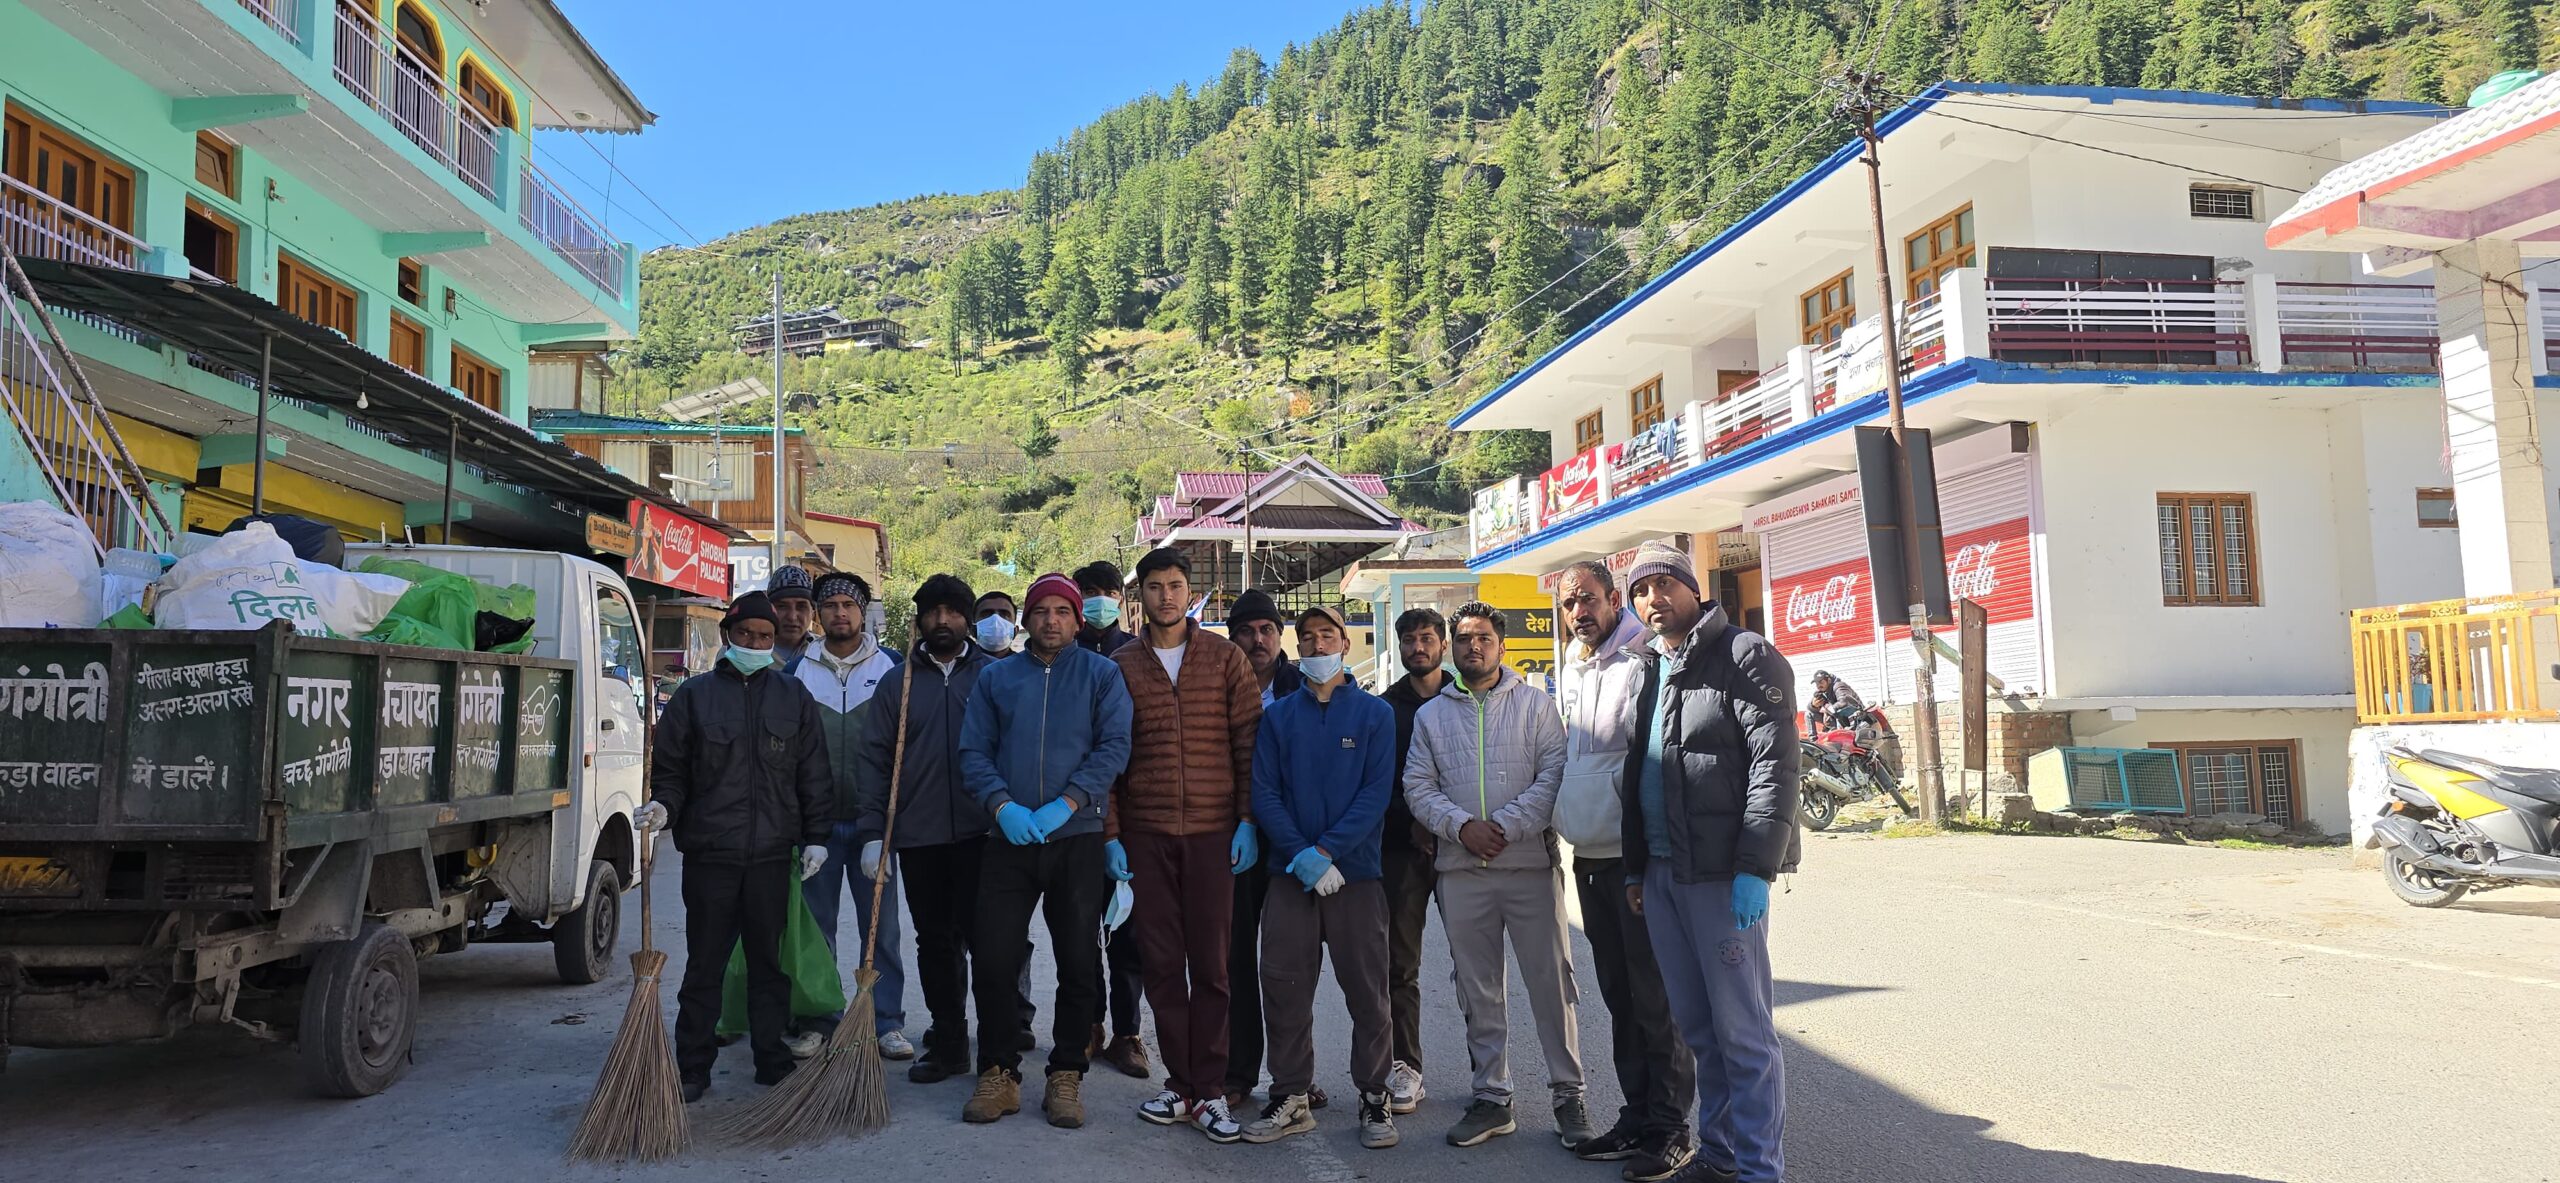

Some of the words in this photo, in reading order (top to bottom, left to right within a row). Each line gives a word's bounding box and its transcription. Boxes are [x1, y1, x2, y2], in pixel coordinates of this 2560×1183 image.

[1753, 515, 1770, 528] HARSIL
[1811, 493, 1838, 512] SAHAKARI
[664, 519, 696, 556] Coca-Cola
[700, 540, 727, 565] SHOBHA
[700, 562, 726, 585] PALACE
[1786, 573, 1858, 632] Coca-Cola
[1525, 612, 1552, 633] देश
[137, 663, 172, 690] गीला
[172, 667, 183, 684] व
[182, 663, 214, 689] सूखा
[214, 658, 249, 685] कूड़ा
[231, 681, 254, 707] रखें
[287, 677, 352, 728] नगर
[132, 756, 156, 790] में
[315, 736, 352, 777] गंगोत्री
[400, 746, 435, 780] वाहन
[472, 740, 500, 774] गंगोत्री
[43, 762, 102, 790] वाहन
